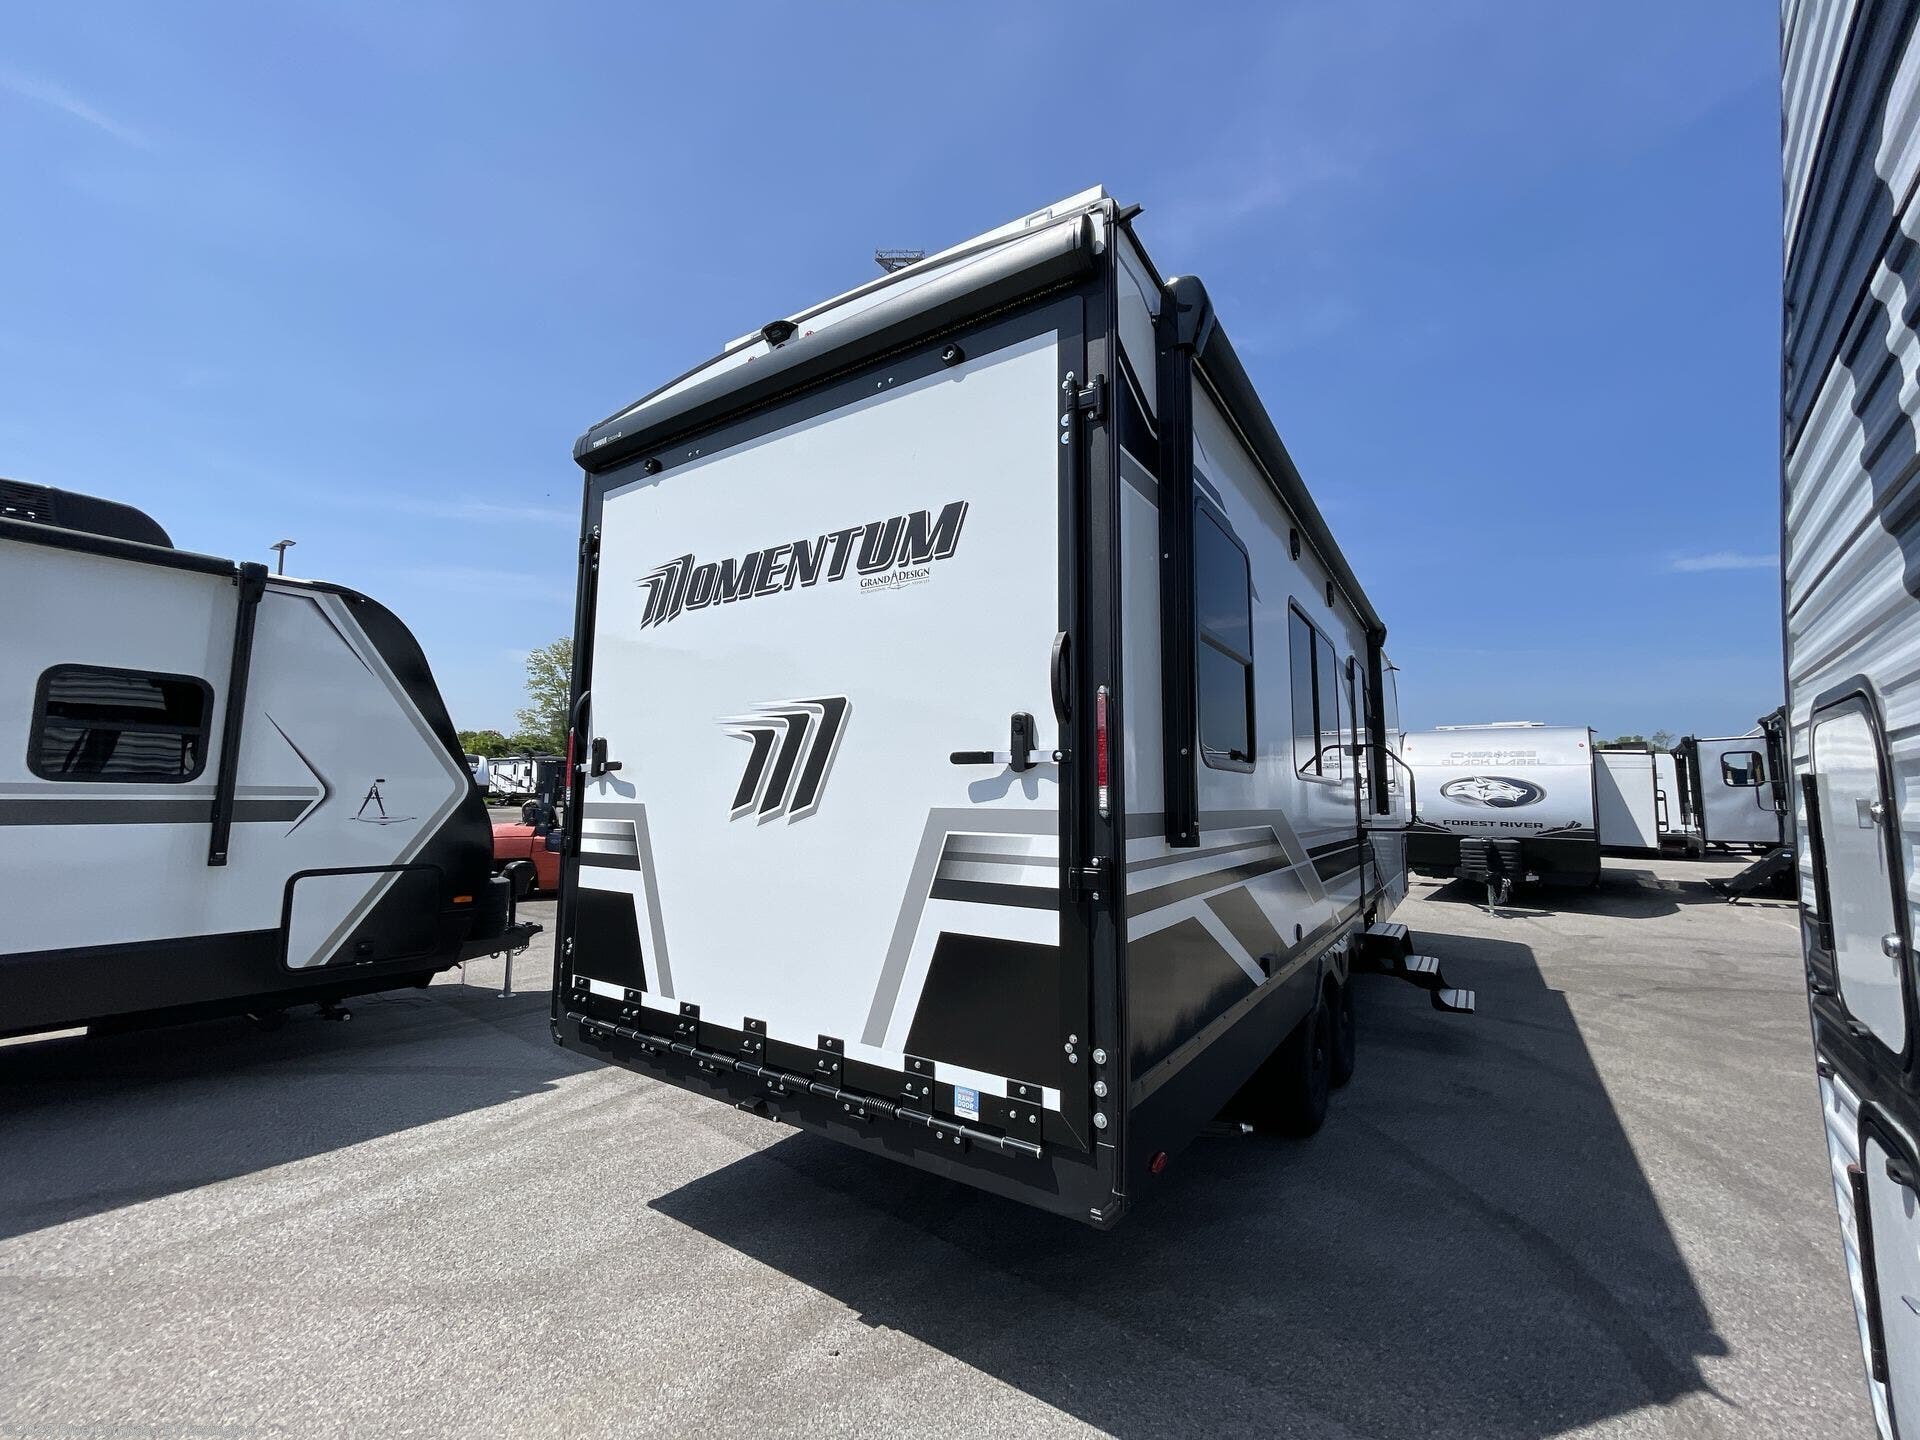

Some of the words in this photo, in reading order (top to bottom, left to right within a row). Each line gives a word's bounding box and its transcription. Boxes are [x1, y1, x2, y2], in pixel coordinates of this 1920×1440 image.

[634, 500, 970, 631] MOMENTUM
[860, 576, 890, 587] GRAND
[898, 568, 930, 580] DESIGN
[1441, 759, 1490, 767] BLACK
[1443, 820, 1497, 828] FOREST
[1500, 821, 1544, 829] RIVER
